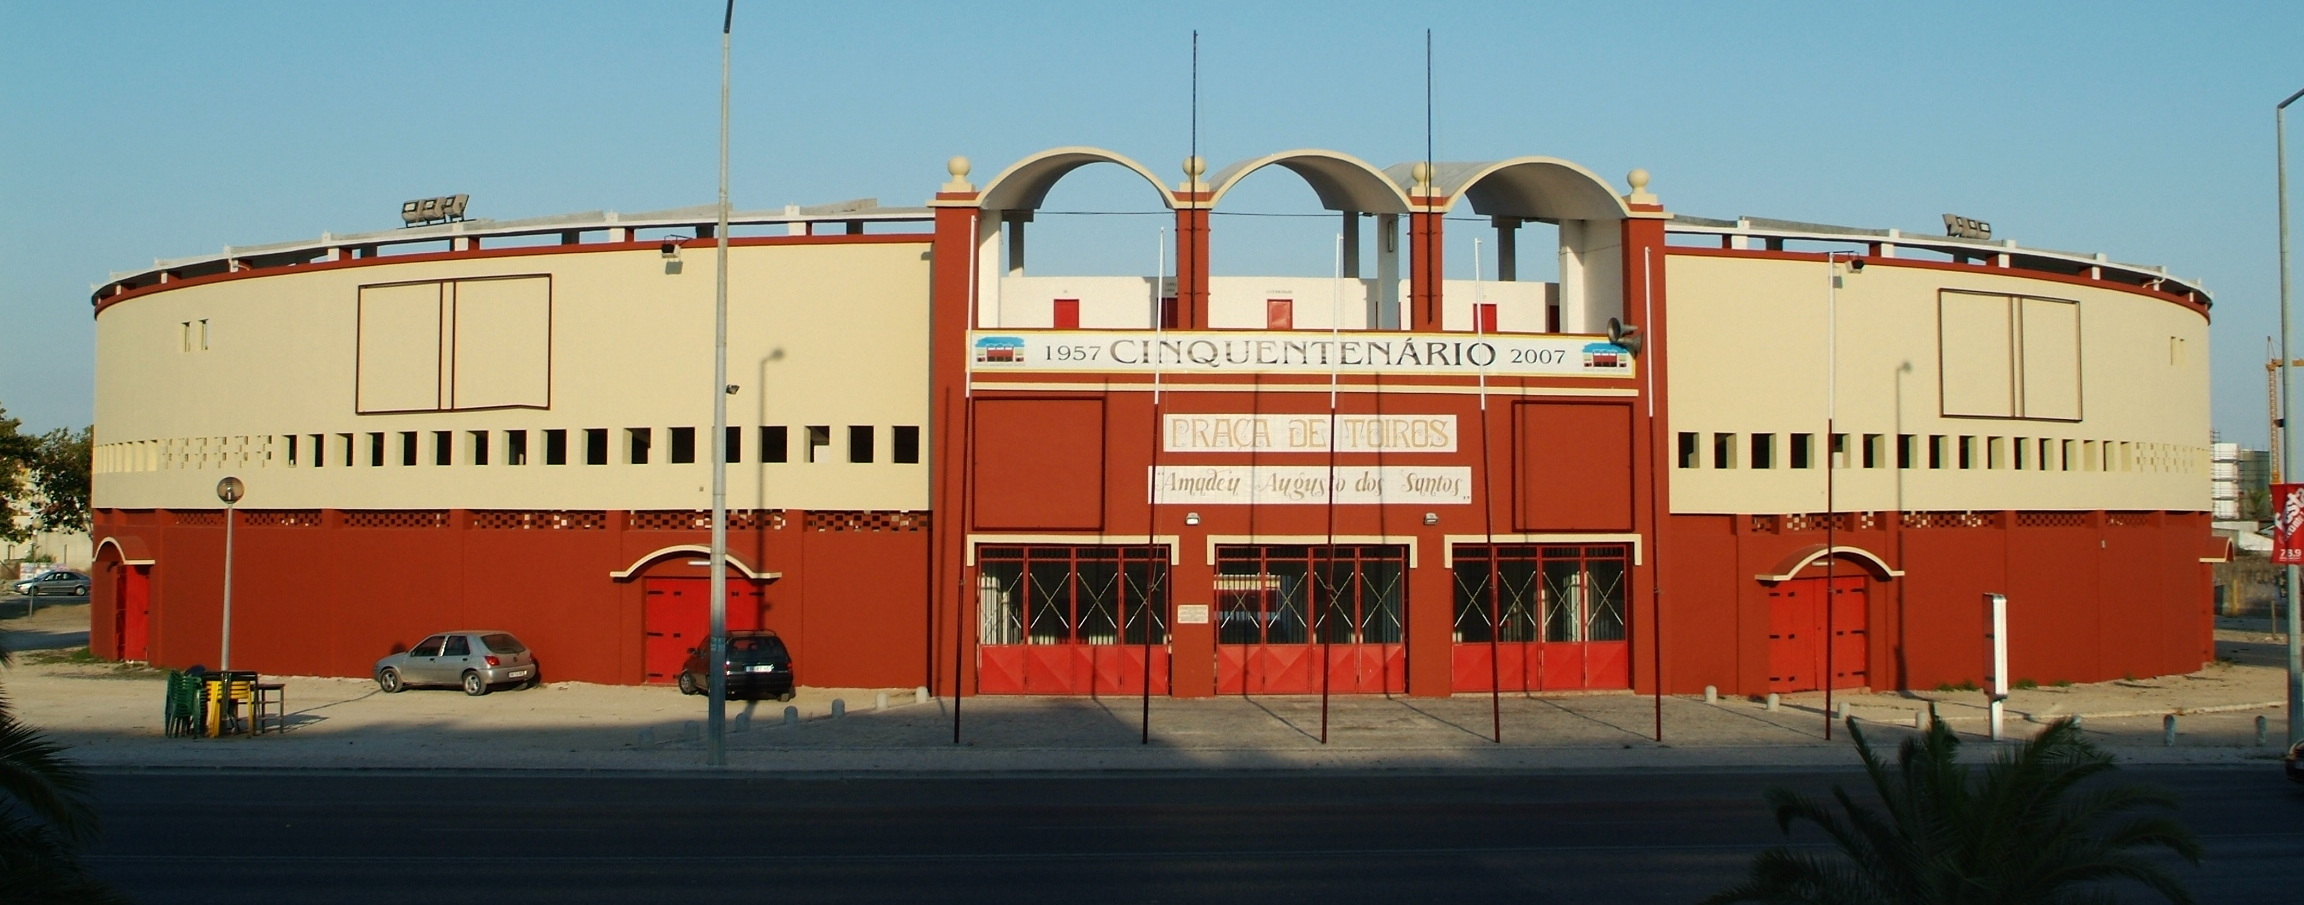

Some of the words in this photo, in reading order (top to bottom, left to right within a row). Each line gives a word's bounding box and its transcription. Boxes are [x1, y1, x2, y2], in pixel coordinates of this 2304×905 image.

[1046, 345, 1101, 361] 1957
[1109, 337, 1497, 368] CINQUENTENÁRIO
[1510, 348, 1566, 364] 2007
[1171, 418, 1272, 450] PRAÇA
[1288, 418, 1327, 448] DE
[1343, 418, 1450, 448] TOIROS
[1256, 471, 1346, 500] Auguso
[1355, 471, 1385, 496] dos
